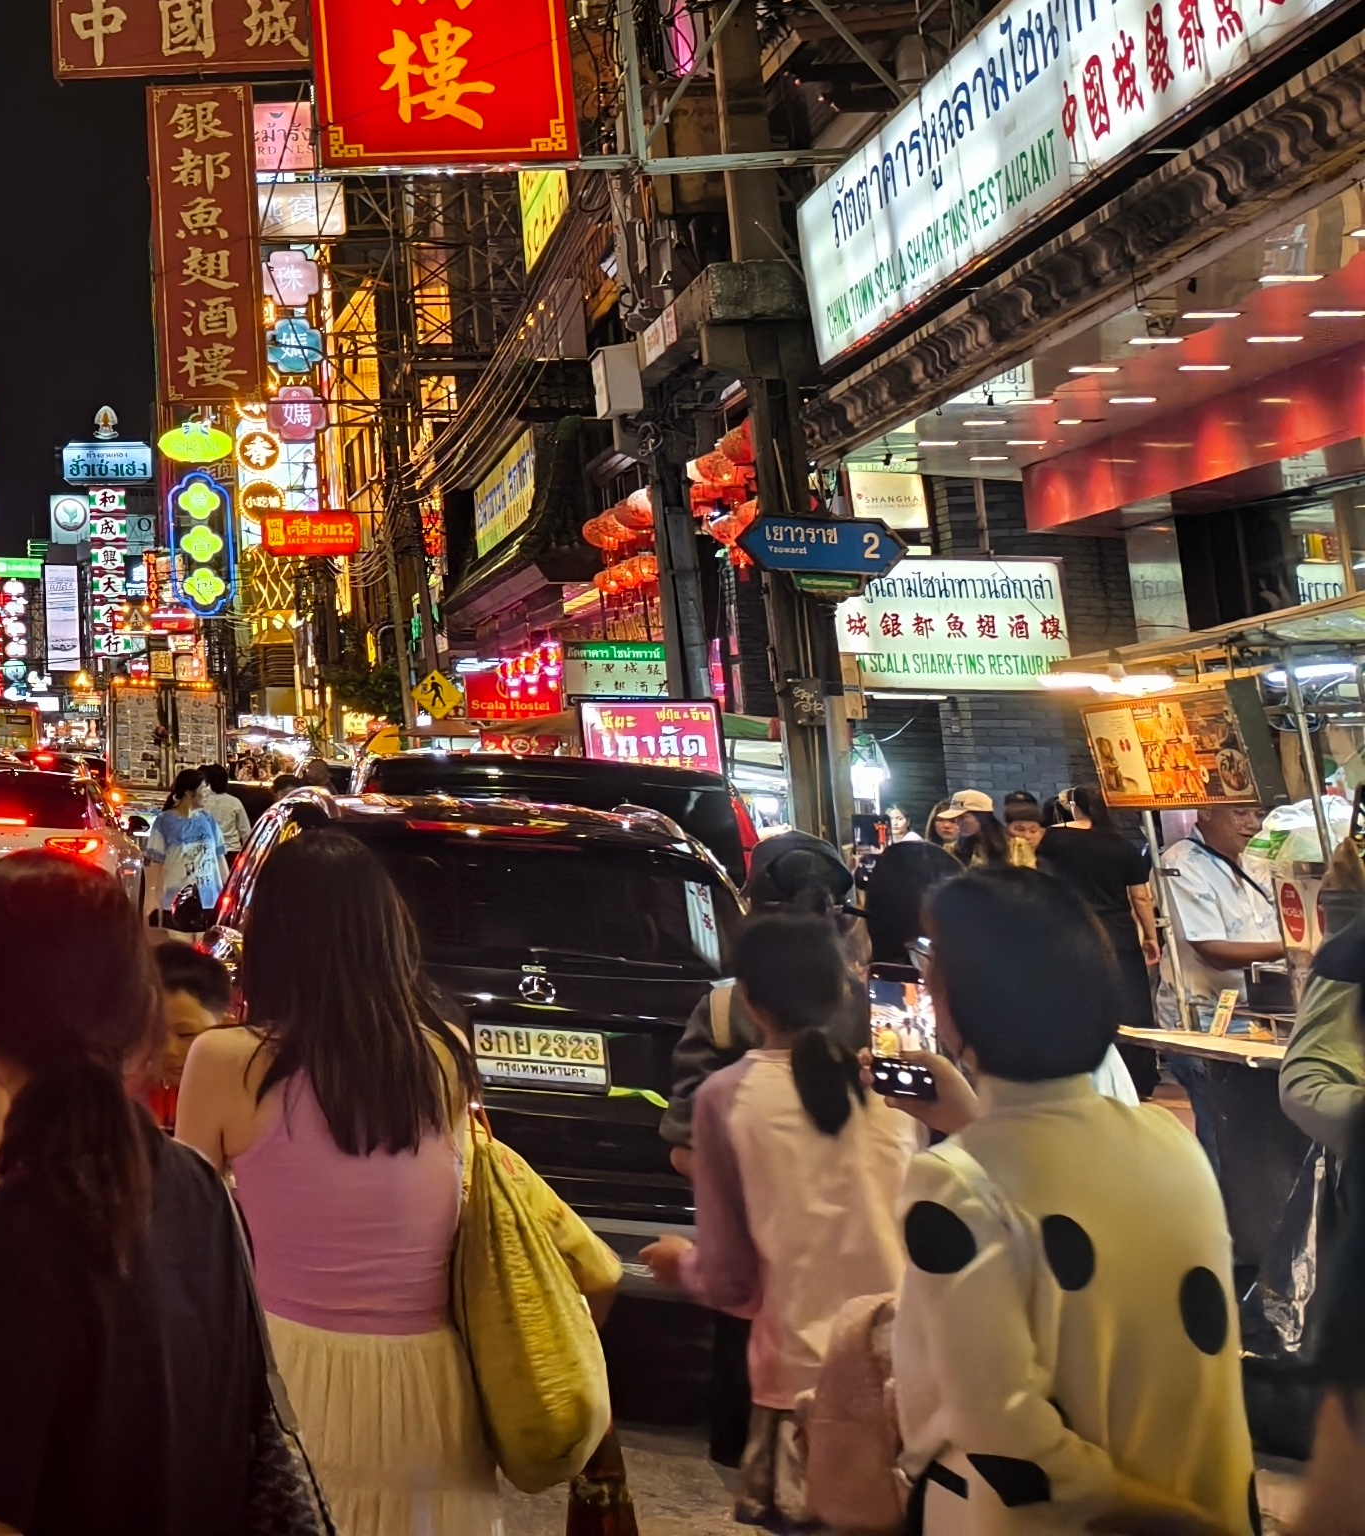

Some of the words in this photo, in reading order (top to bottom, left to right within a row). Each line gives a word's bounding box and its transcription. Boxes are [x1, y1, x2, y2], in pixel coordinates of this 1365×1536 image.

[167, 101, 249, 391] 銀都魚翅酒樓
[826, 294, 852, 341] CHINA
[849, 272, 876, 323] TOWN
[874, 247, 909, 303] SCALA
[906, 198, 970, 280] SHARK-FINS
[968, 127, 1059, 233] RESTAURANT
[765, 525, 838, 545] เยาวราช
[862, 532, 881, 559] 2
[845, 611, 1064, 641] 城銀都魚翅酒樓
[869, 652, 911, 674] SCALA
[913, 652, 987, 676] SHARK-FINS
[471, 699, 507, 712] Scala
[509, 700, 551, 712] Hostel
[479, 1028, 532, 1055] 3กย
[537, 1032, 600, 1061] 2323
[495, 1061, 588, 1078] กรุงเทพมหานคร
